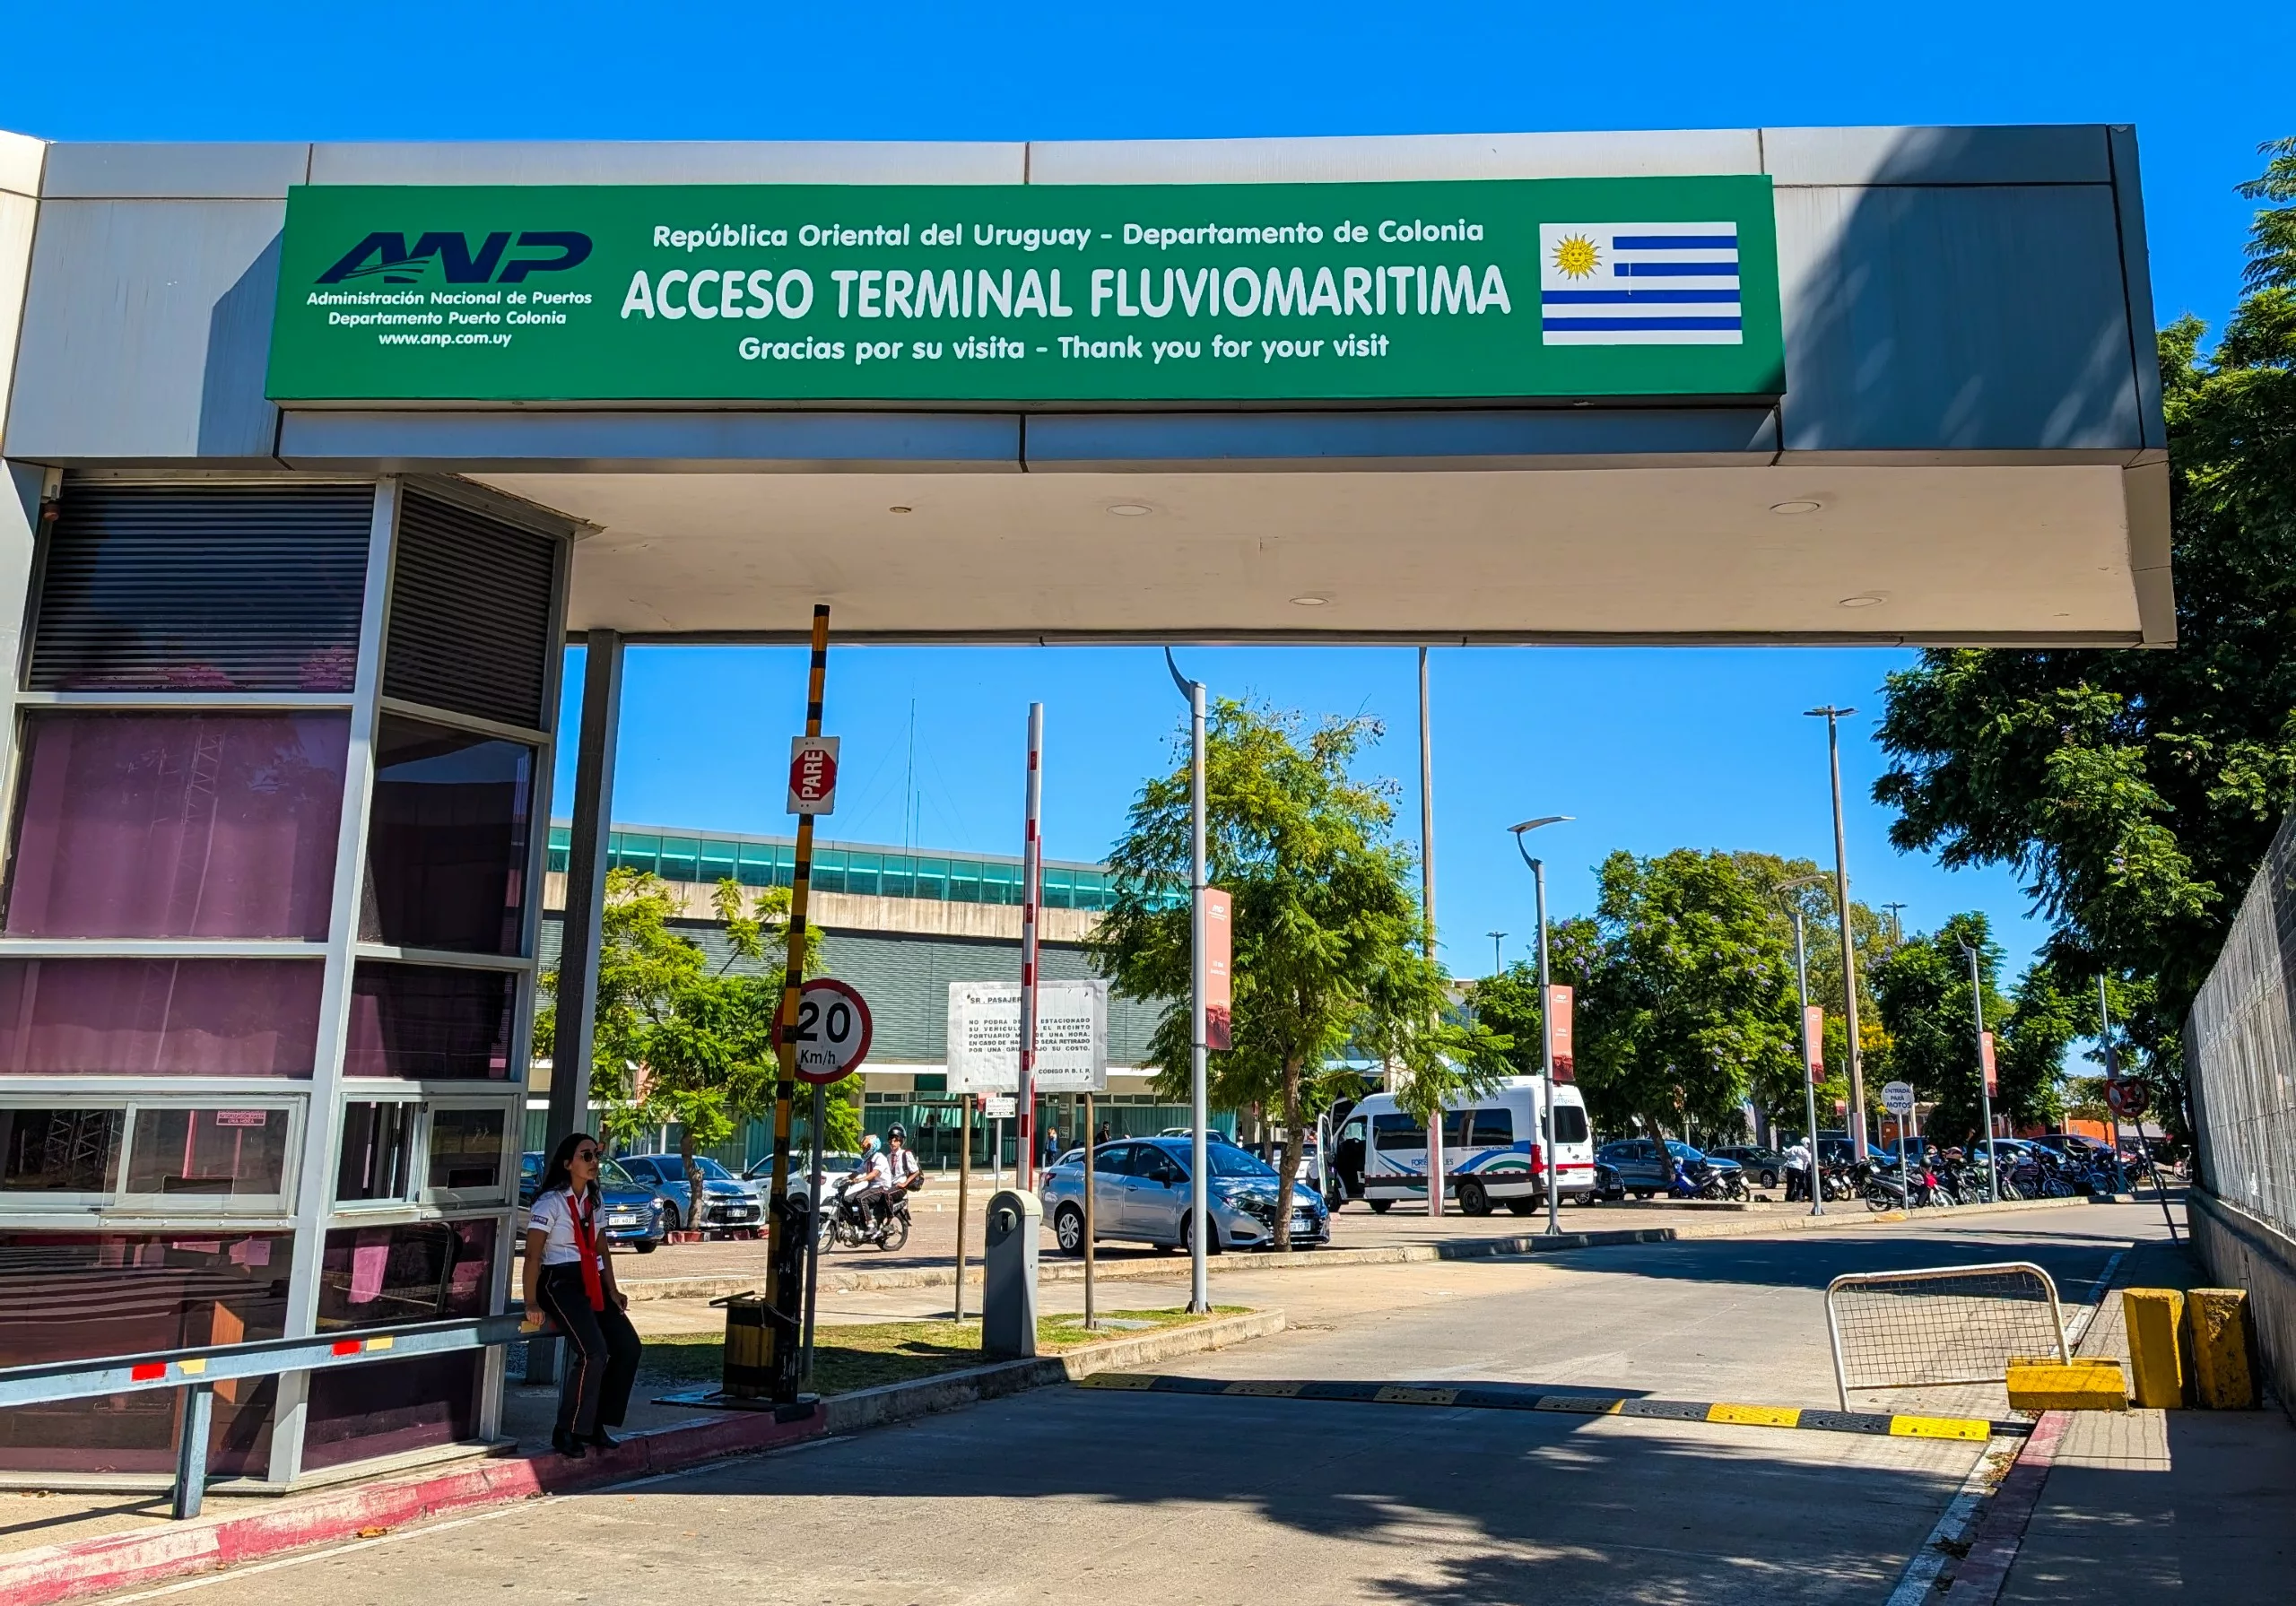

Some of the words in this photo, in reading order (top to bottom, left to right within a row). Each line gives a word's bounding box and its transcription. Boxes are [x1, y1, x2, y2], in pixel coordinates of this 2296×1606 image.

[654, 223, 787, 254] República
[798, 223, 909, 247] Oriental
[920, 223, 962, 247] del
[974, 224, 1091, 252] Uruguay
[1124, 222, 1324, 251] Departamento
[1334, 220, 1369, 243] de
[1378, 220, 1484, 243] Colonia
[313, 231, 593, 283] ANP
[307, 291, 424, 306] Administración
[430, 291, 501, 305] Nacional
[507, 291, 526, 305] de
[532, 291, 592, 305] Puertos
[621, 269, 814, 319] ACCESO
[831, 268, 1073, 318] TERMINAL
[1091, 265, 1511, 318] FLUVIOMARITIMA
[329, 312, 443, 327] Departamento
[448, 311, 500, 326] Puerto
[506, 310, 567, 325] Colonia
[378, 333, 512, 348] www.anp.com.uy
[738, 336, 845, 360] Gracias
[856, 342, 903, 365] por
[912, 342, 943, 360] su
[952, 336, 1024, 360] visita
[1057, 335, 1143, 359] Thank
[1152, 340, 1201, 364] you
[1212, 334, 1253, 358] for
[1261, 340, 1325, 363] your
[1333, 333, 1389, 357] visit
[802, 750, 824, 798] PARE
[797, 1002, 851, 1043] 20
[800, 1049, 836, 1065] Km/h
